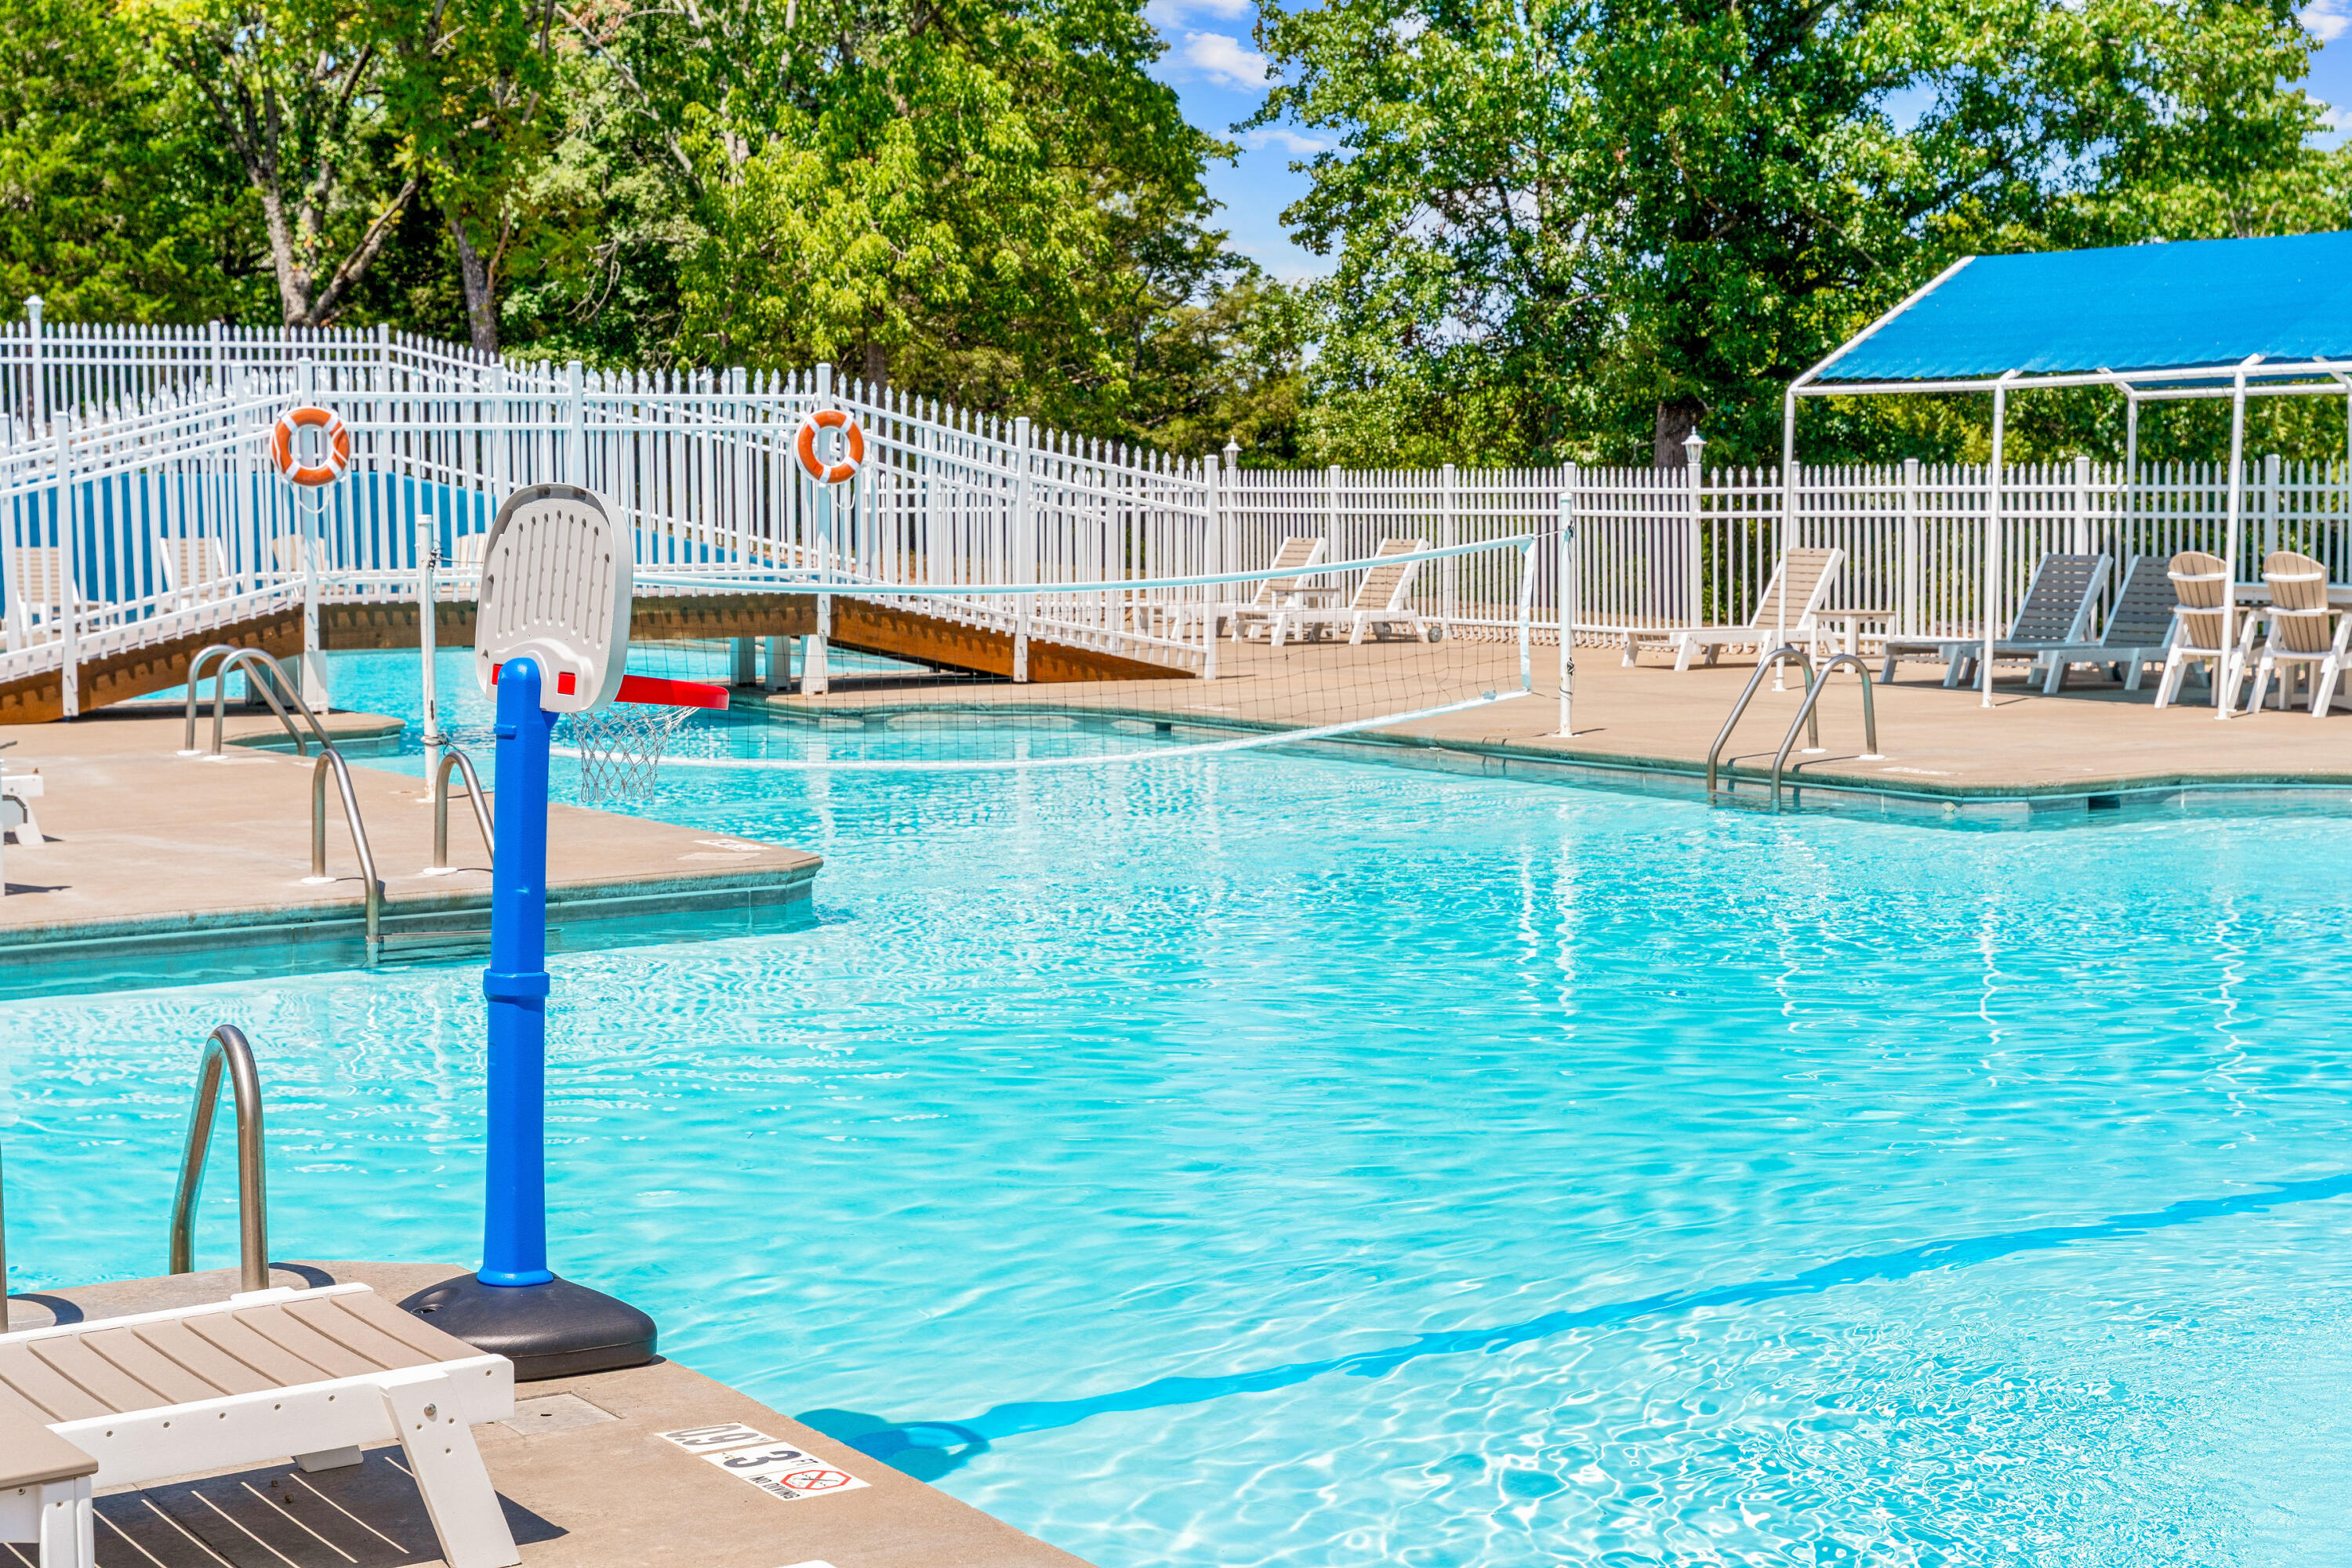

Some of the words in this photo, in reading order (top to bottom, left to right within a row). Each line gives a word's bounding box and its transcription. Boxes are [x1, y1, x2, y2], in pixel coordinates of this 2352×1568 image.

[724, 1450, 801, 1468] 3
[749, 1475, 771, 1484] NO
[762, 1483, 800, 1499] DIVING
